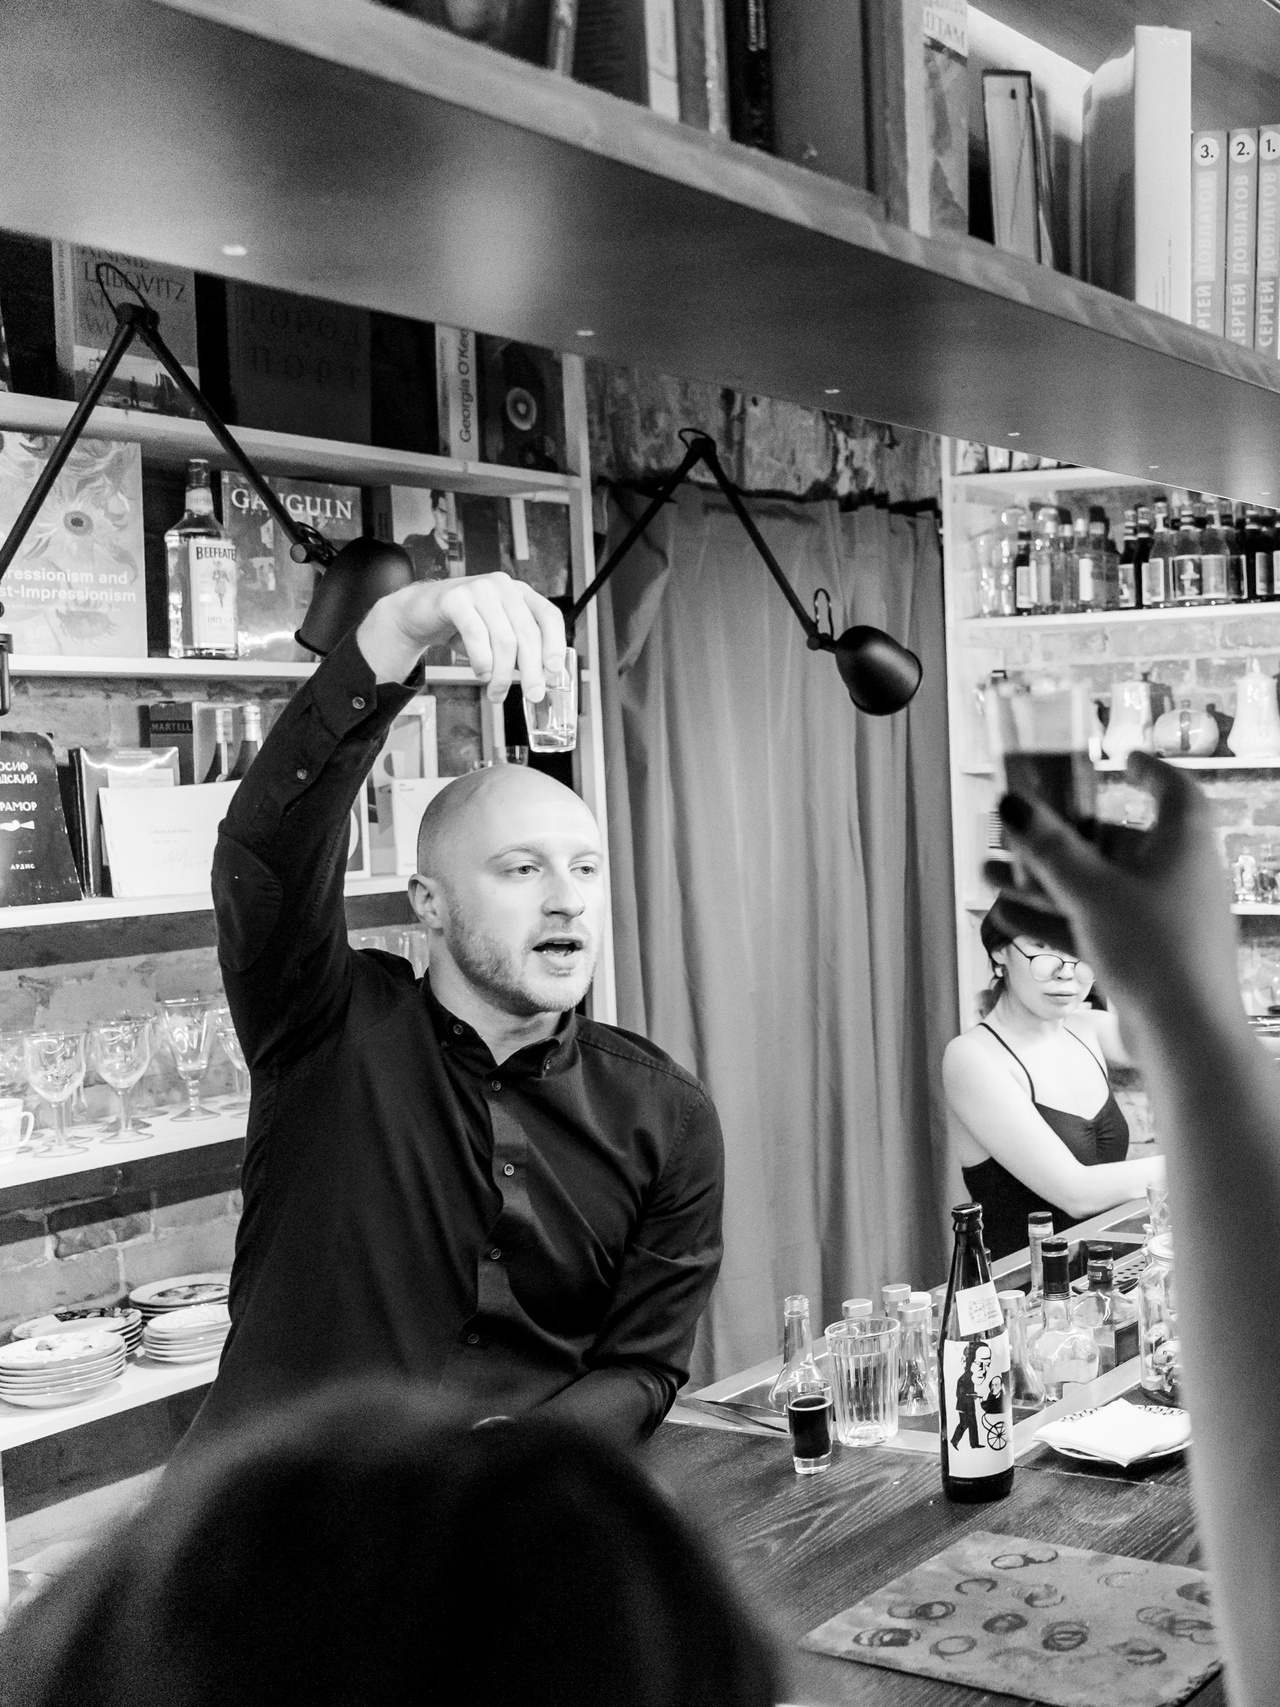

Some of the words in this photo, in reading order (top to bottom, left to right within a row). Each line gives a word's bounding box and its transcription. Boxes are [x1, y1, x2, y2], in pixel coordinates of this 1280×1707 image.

[1200, 143, 1214, 159] 3.
[1236, 141, 1250, 156] 2.
[1265, 138, 1276, 152] 1.
[1196, 176, 1213, 277] ДОВЛАТОВ
[1232, 174, 1250, 275] ДОВЛАТОВ
[1260, 171, 1277, 273] ДОВЛАТОВ
[1259, 279, 1275, 347] СЕРГЕЙ
[458, 378, 474, 443] Georgia
[98, 571, 128, 585] and
[151, 722, 192, 733] MARTELL
[0, 771, 38, 784] ДСКИЙ
